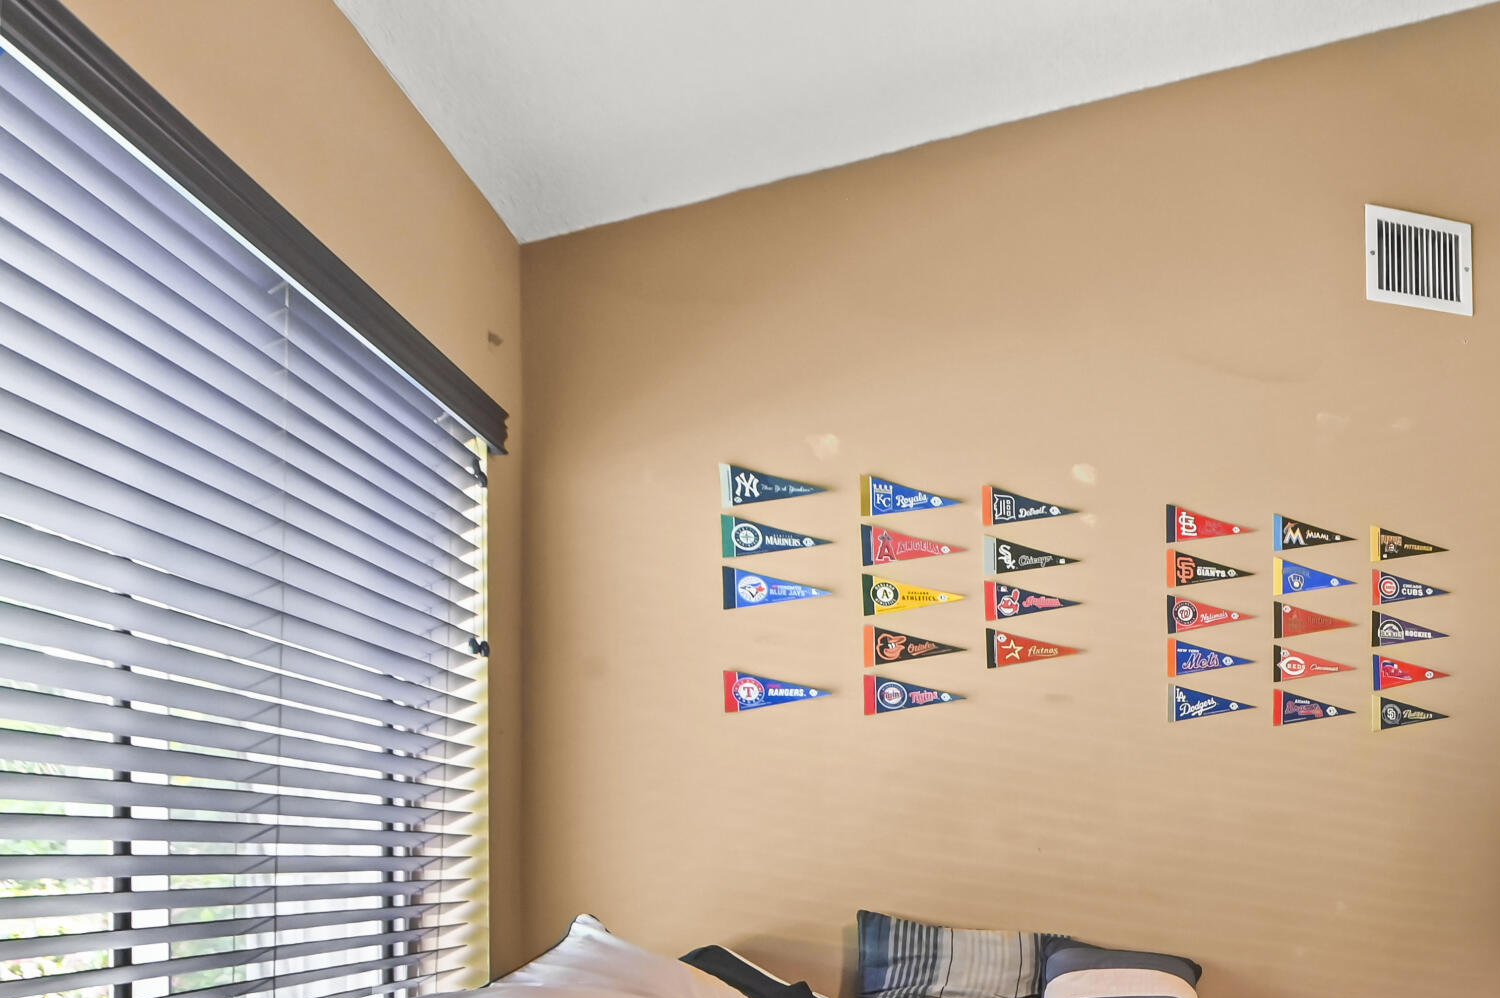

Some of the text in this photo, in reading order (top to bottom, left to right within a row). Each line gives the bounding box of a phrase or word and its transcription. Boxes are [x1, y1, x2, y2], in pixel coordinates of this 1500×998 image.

[735, 472, 760, 498] NY
[876, 493, 892, 508] KC
[895, 491, 929, 509] Royals
[1018, 505, 1048, 519] Detroit
[765, 536, 802, 547] MARINERS
[1305, 529, 1329, 541] MIAMI
[896, 540, 940, 556] ANGELS
[1018, 555, 1054, 568] Chicago
[1176, 556, 1196, 583] SF
[1196, 568, 1227, 578] GIANTS
[1401, 588, 1424, 597] CUBS
[1182, 651, 1220, 670] Mets
[767, 688, 806, 697] RANGERS
[1176, 688, 1187, 702] LA
[1180, 697, 1218, 717] Dodgers
